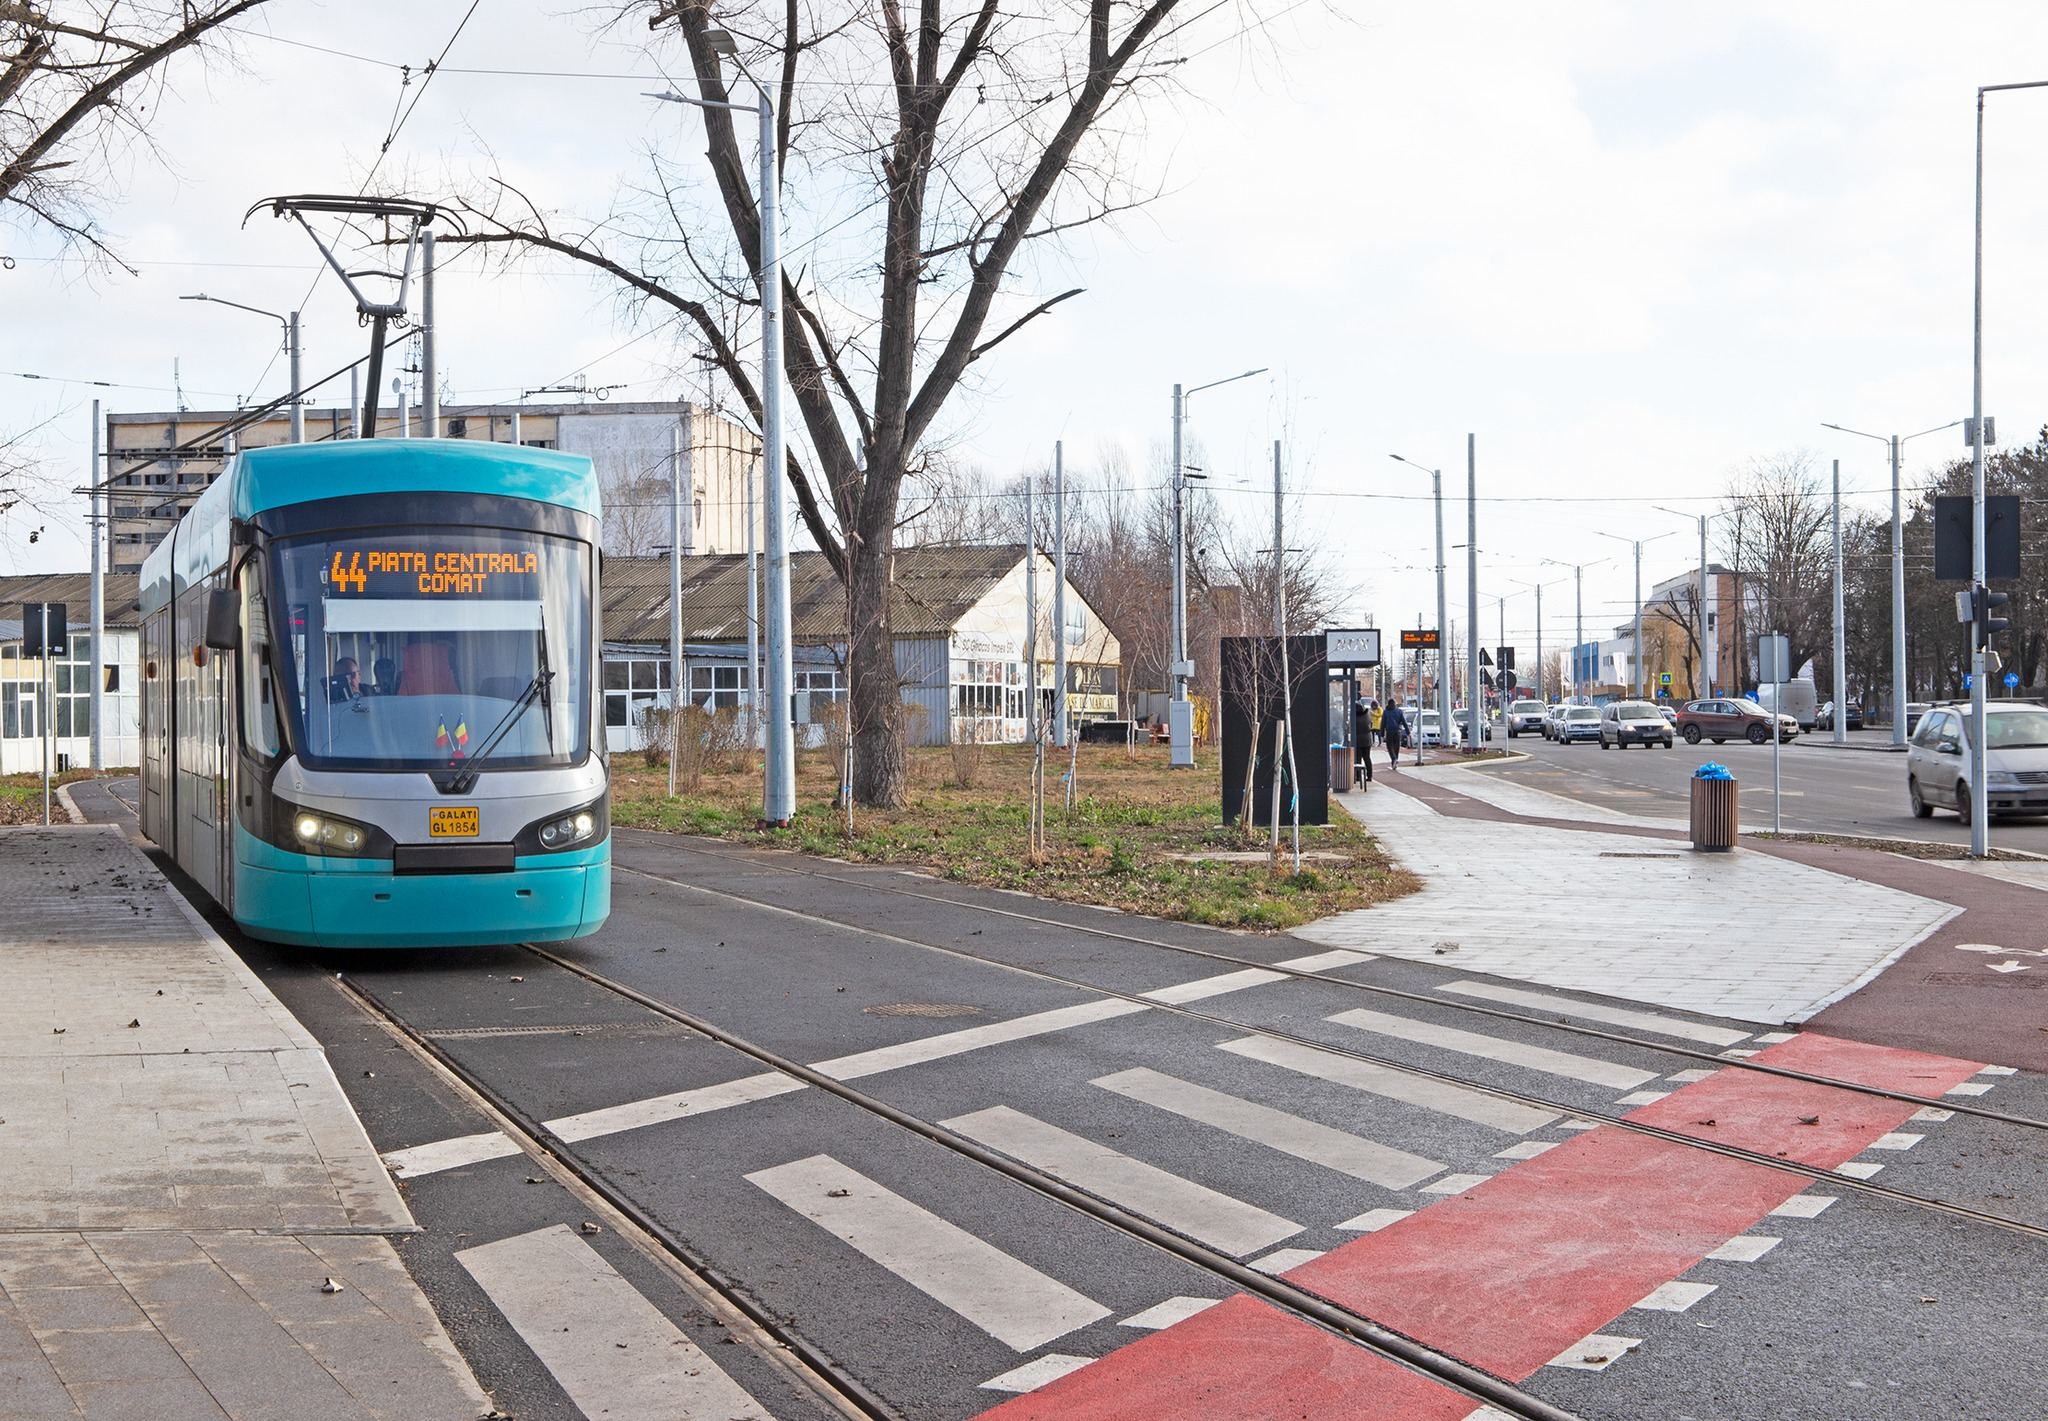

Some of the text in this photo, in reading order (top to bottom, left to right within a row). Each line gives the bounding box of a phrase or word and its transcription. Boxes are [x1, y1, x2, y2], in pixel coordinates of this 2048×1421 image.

[331, 551, 538, 593] 44 PIATA CENTRALA
[418, 573, 487, 593] COMAT
[439, 810, 476, 819] GALATI
[433, 822, 476, 833] GL 1854
